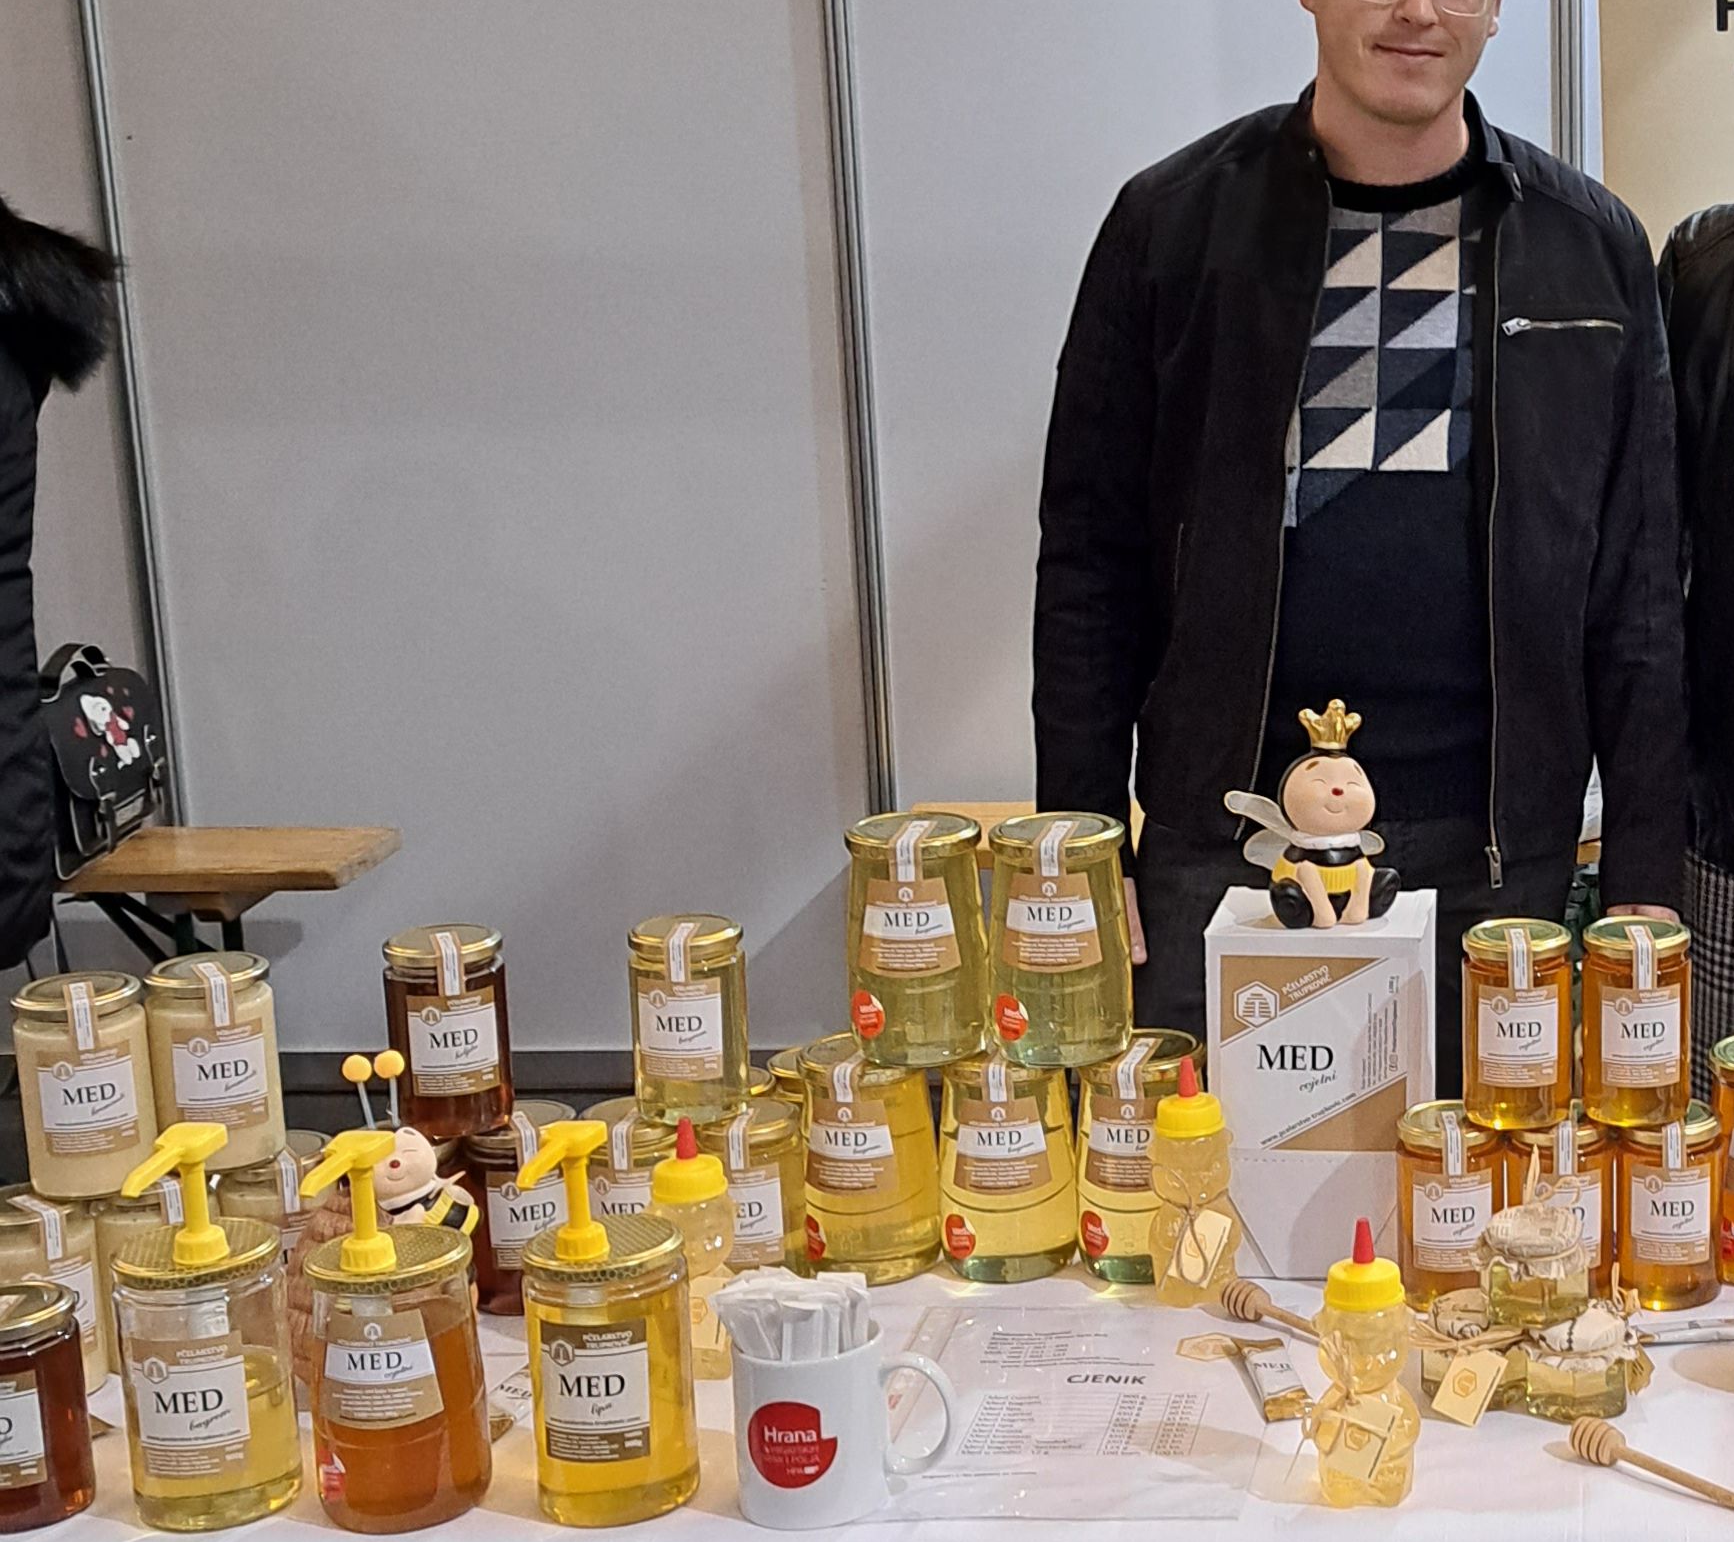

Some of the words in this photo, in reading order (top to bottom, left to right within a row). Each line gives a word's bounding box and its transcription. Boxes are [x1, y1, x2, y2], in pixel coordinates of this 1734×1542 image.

[884, 911, 930, 928] MED
[1027, 906, 1073, 922] MED
[656, 1015, 704, 1033] MED
[1496, 1021, 1542, 1038] MED
[1620, 1021, 1666, 1040] MED
[429, 1028, 479, 1050] MED
[1256, 1043, 1334, 1072] MED
[197, 1059, 250, 1082] MED
[61, 1082, 117, 1107] MED
[824, 1130, 868, 1147] MED
[977, 1129, 1022, 1146] MED
[1106, 1127, 1151, 1145] MED
[508, 1201, 557, 1224] MED
[735, 1201, 764, 1219] ED
[1430, 1206, 1476, 1225] MED
[1650, 1200, 1695, 1218] MED
[347, 1351, 403, 1371] MED
[558, 1373, 626, 1398] MED
[1066, 1373, 1147, 1385] CJENIK
[153, 1388, 223, 1415] MED
[763, 1425, 817, 1444] Hrana
